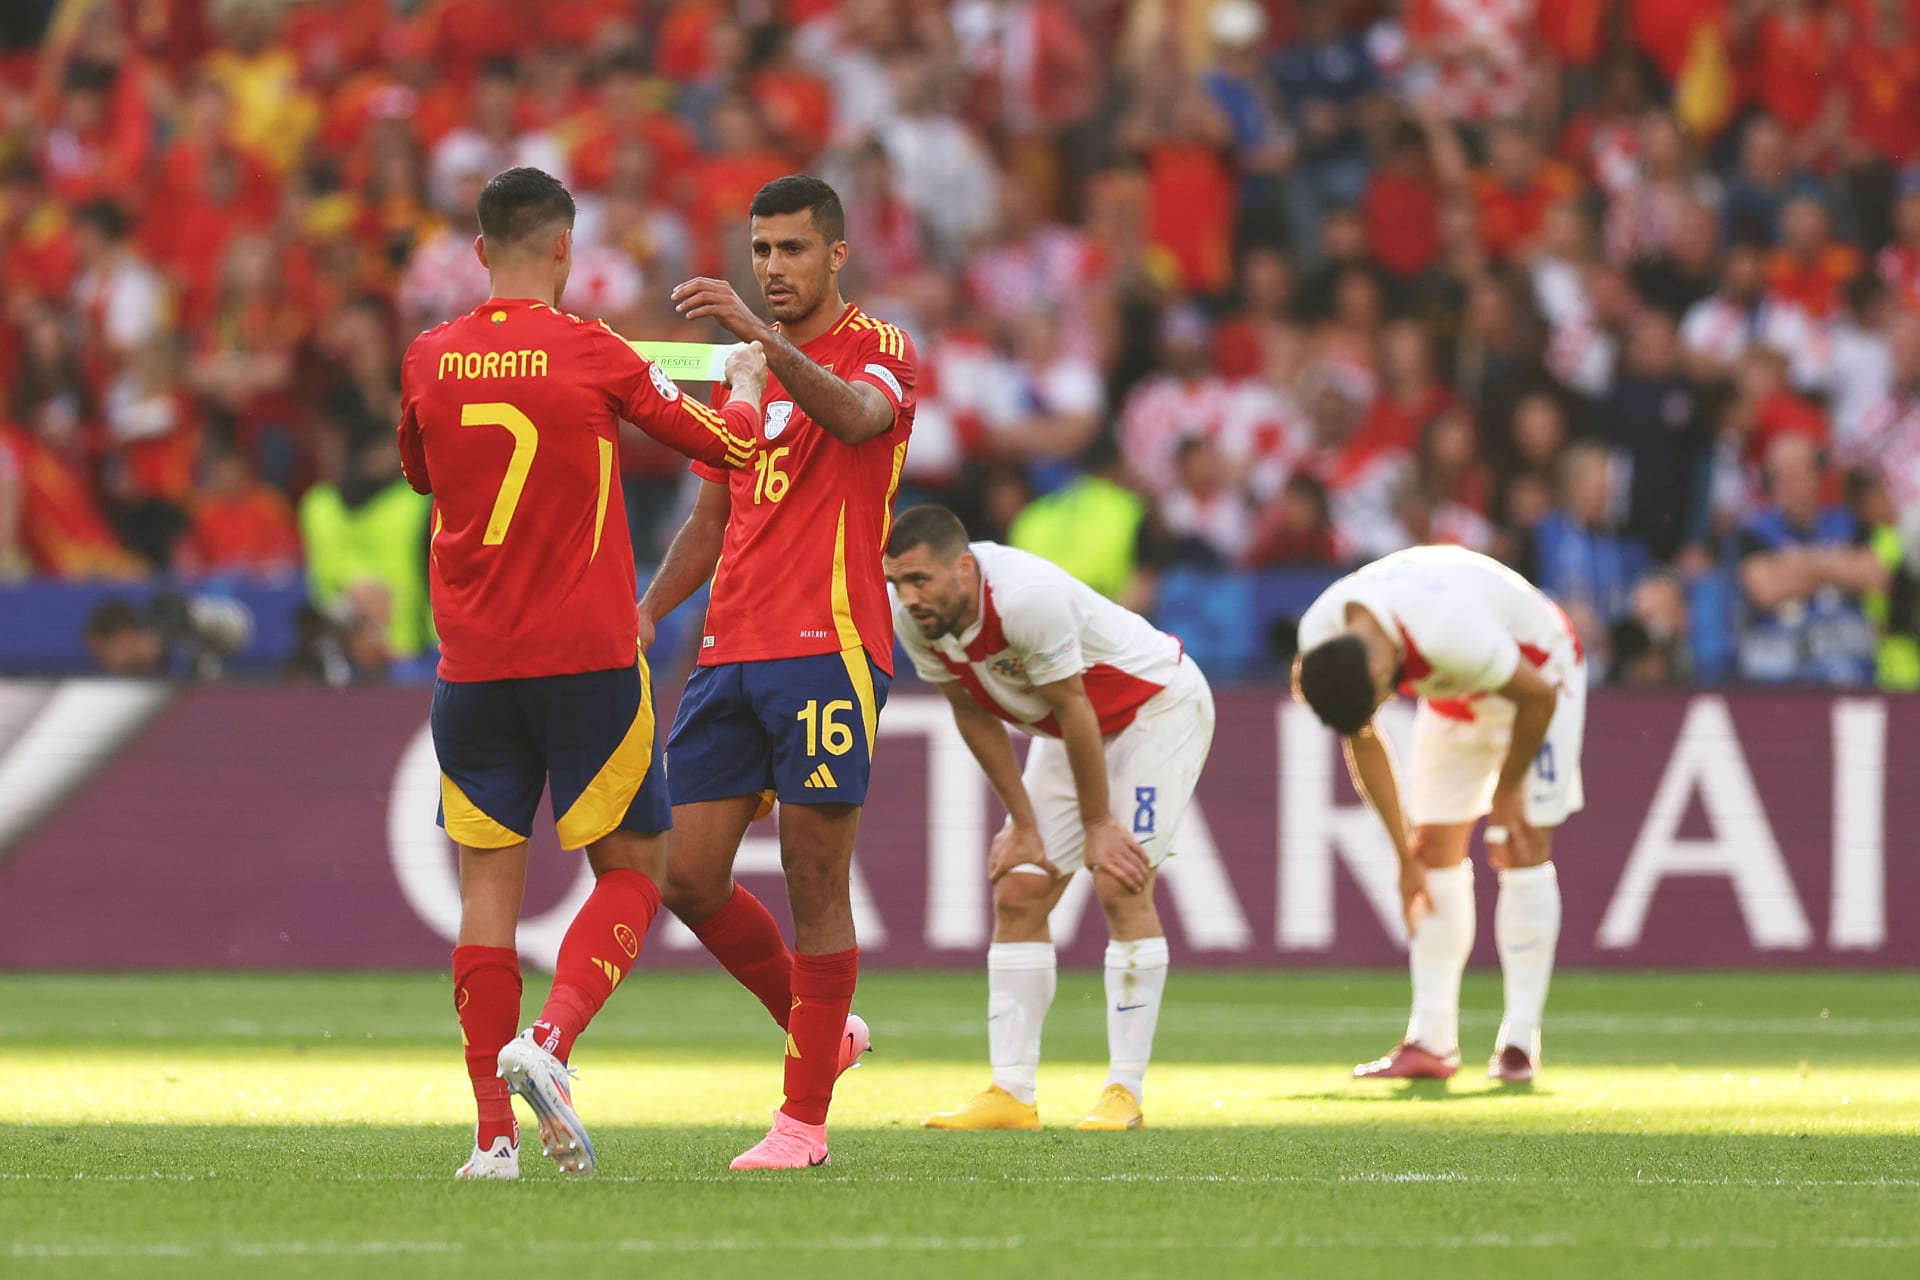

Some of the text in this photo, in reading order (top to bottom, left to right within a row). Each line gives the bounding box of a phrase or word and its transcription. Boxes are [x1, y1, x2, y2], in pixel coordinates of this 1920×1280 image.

[438, 349, 548, 380] MORATA
[660, 358, 702, 367] RESPECT
[461, 402, 538, 545] 7
[754, 447, 790, 504] 16
[797, 699, 853, 756] 16
[1133, 786, 1156, 834] 8
